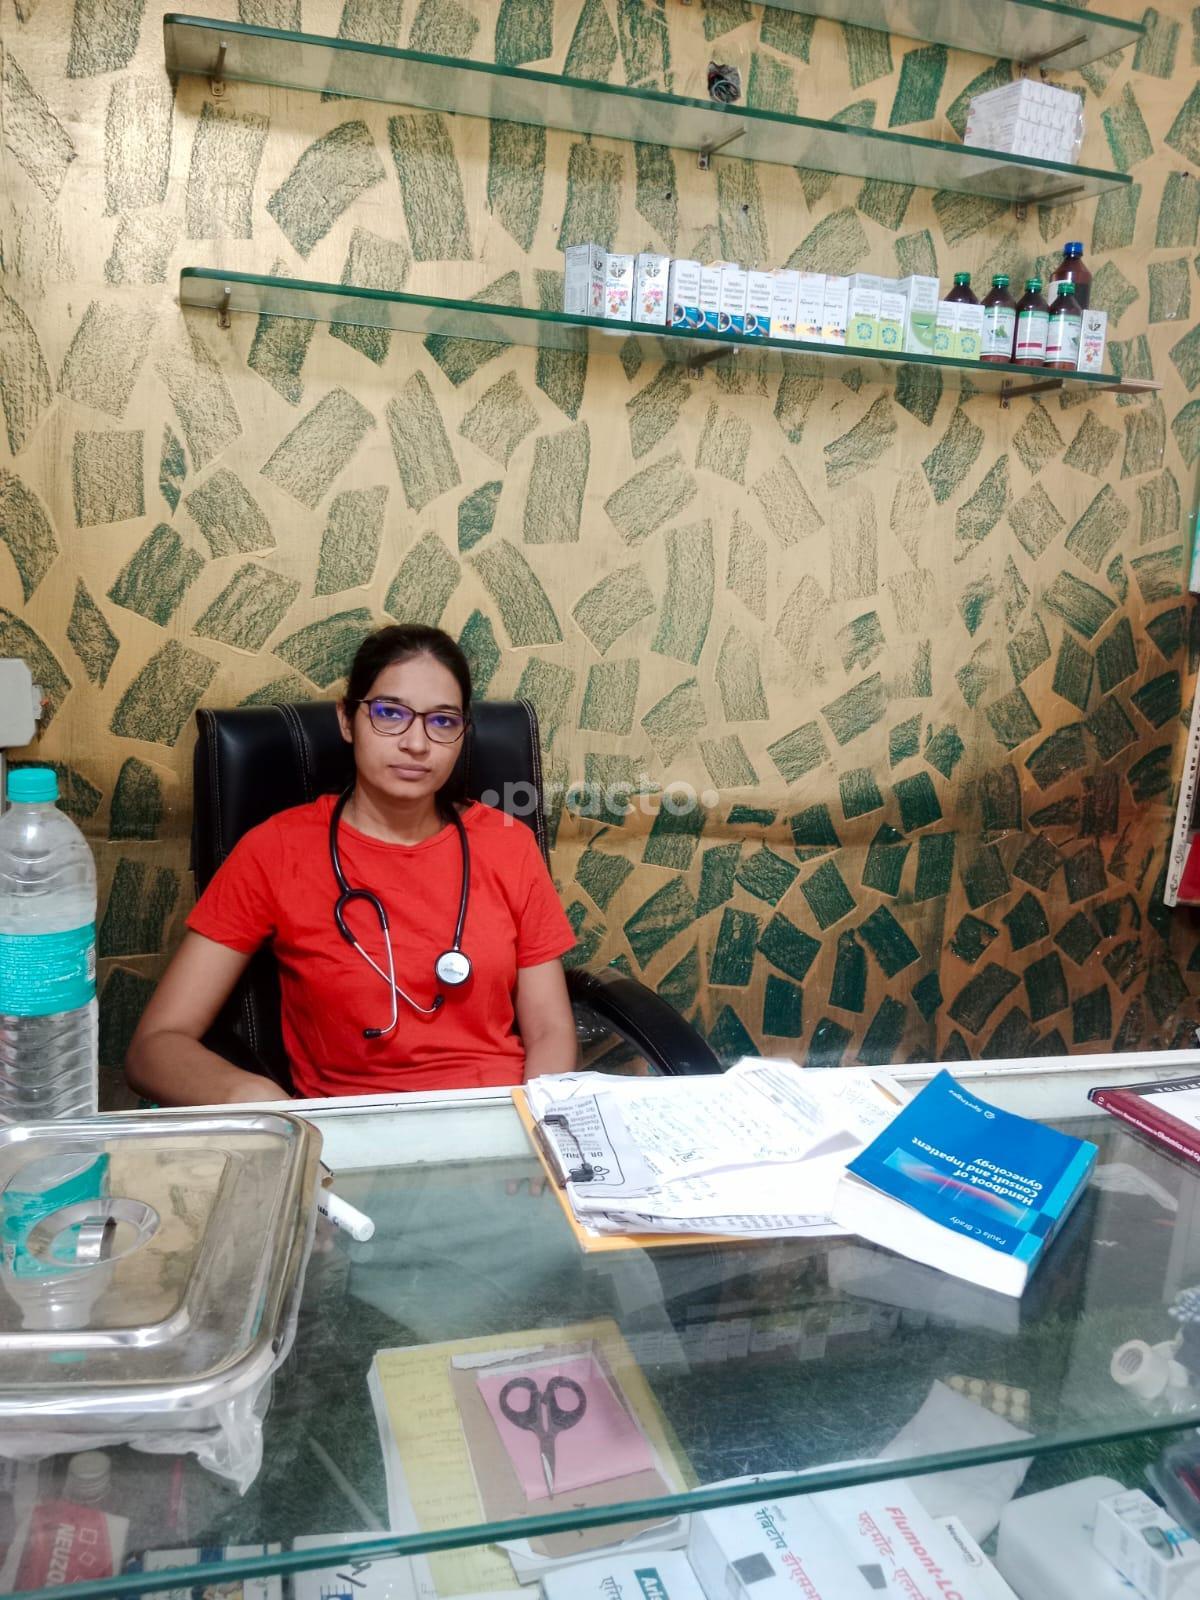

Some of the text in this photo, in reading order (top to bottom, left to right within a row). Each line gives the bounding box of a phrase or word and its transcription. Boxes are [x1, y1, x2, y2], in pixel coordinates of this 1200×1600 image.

[948, 1089, 983, 1113] Springer
[1154, 1082, 1200, 1092] VOLUM
[911, 1136, 1039, 1199] Consult and Inpatient
[973, 1158, 1044, 1191] Gynecology
[952, 1169, 1034, 1206] Handbook of
[949, 1216, 974, 1232] Brady
[983, 1231, 1007, 1246] Paula
[45, 1523, 76, 1587] NEUZO
